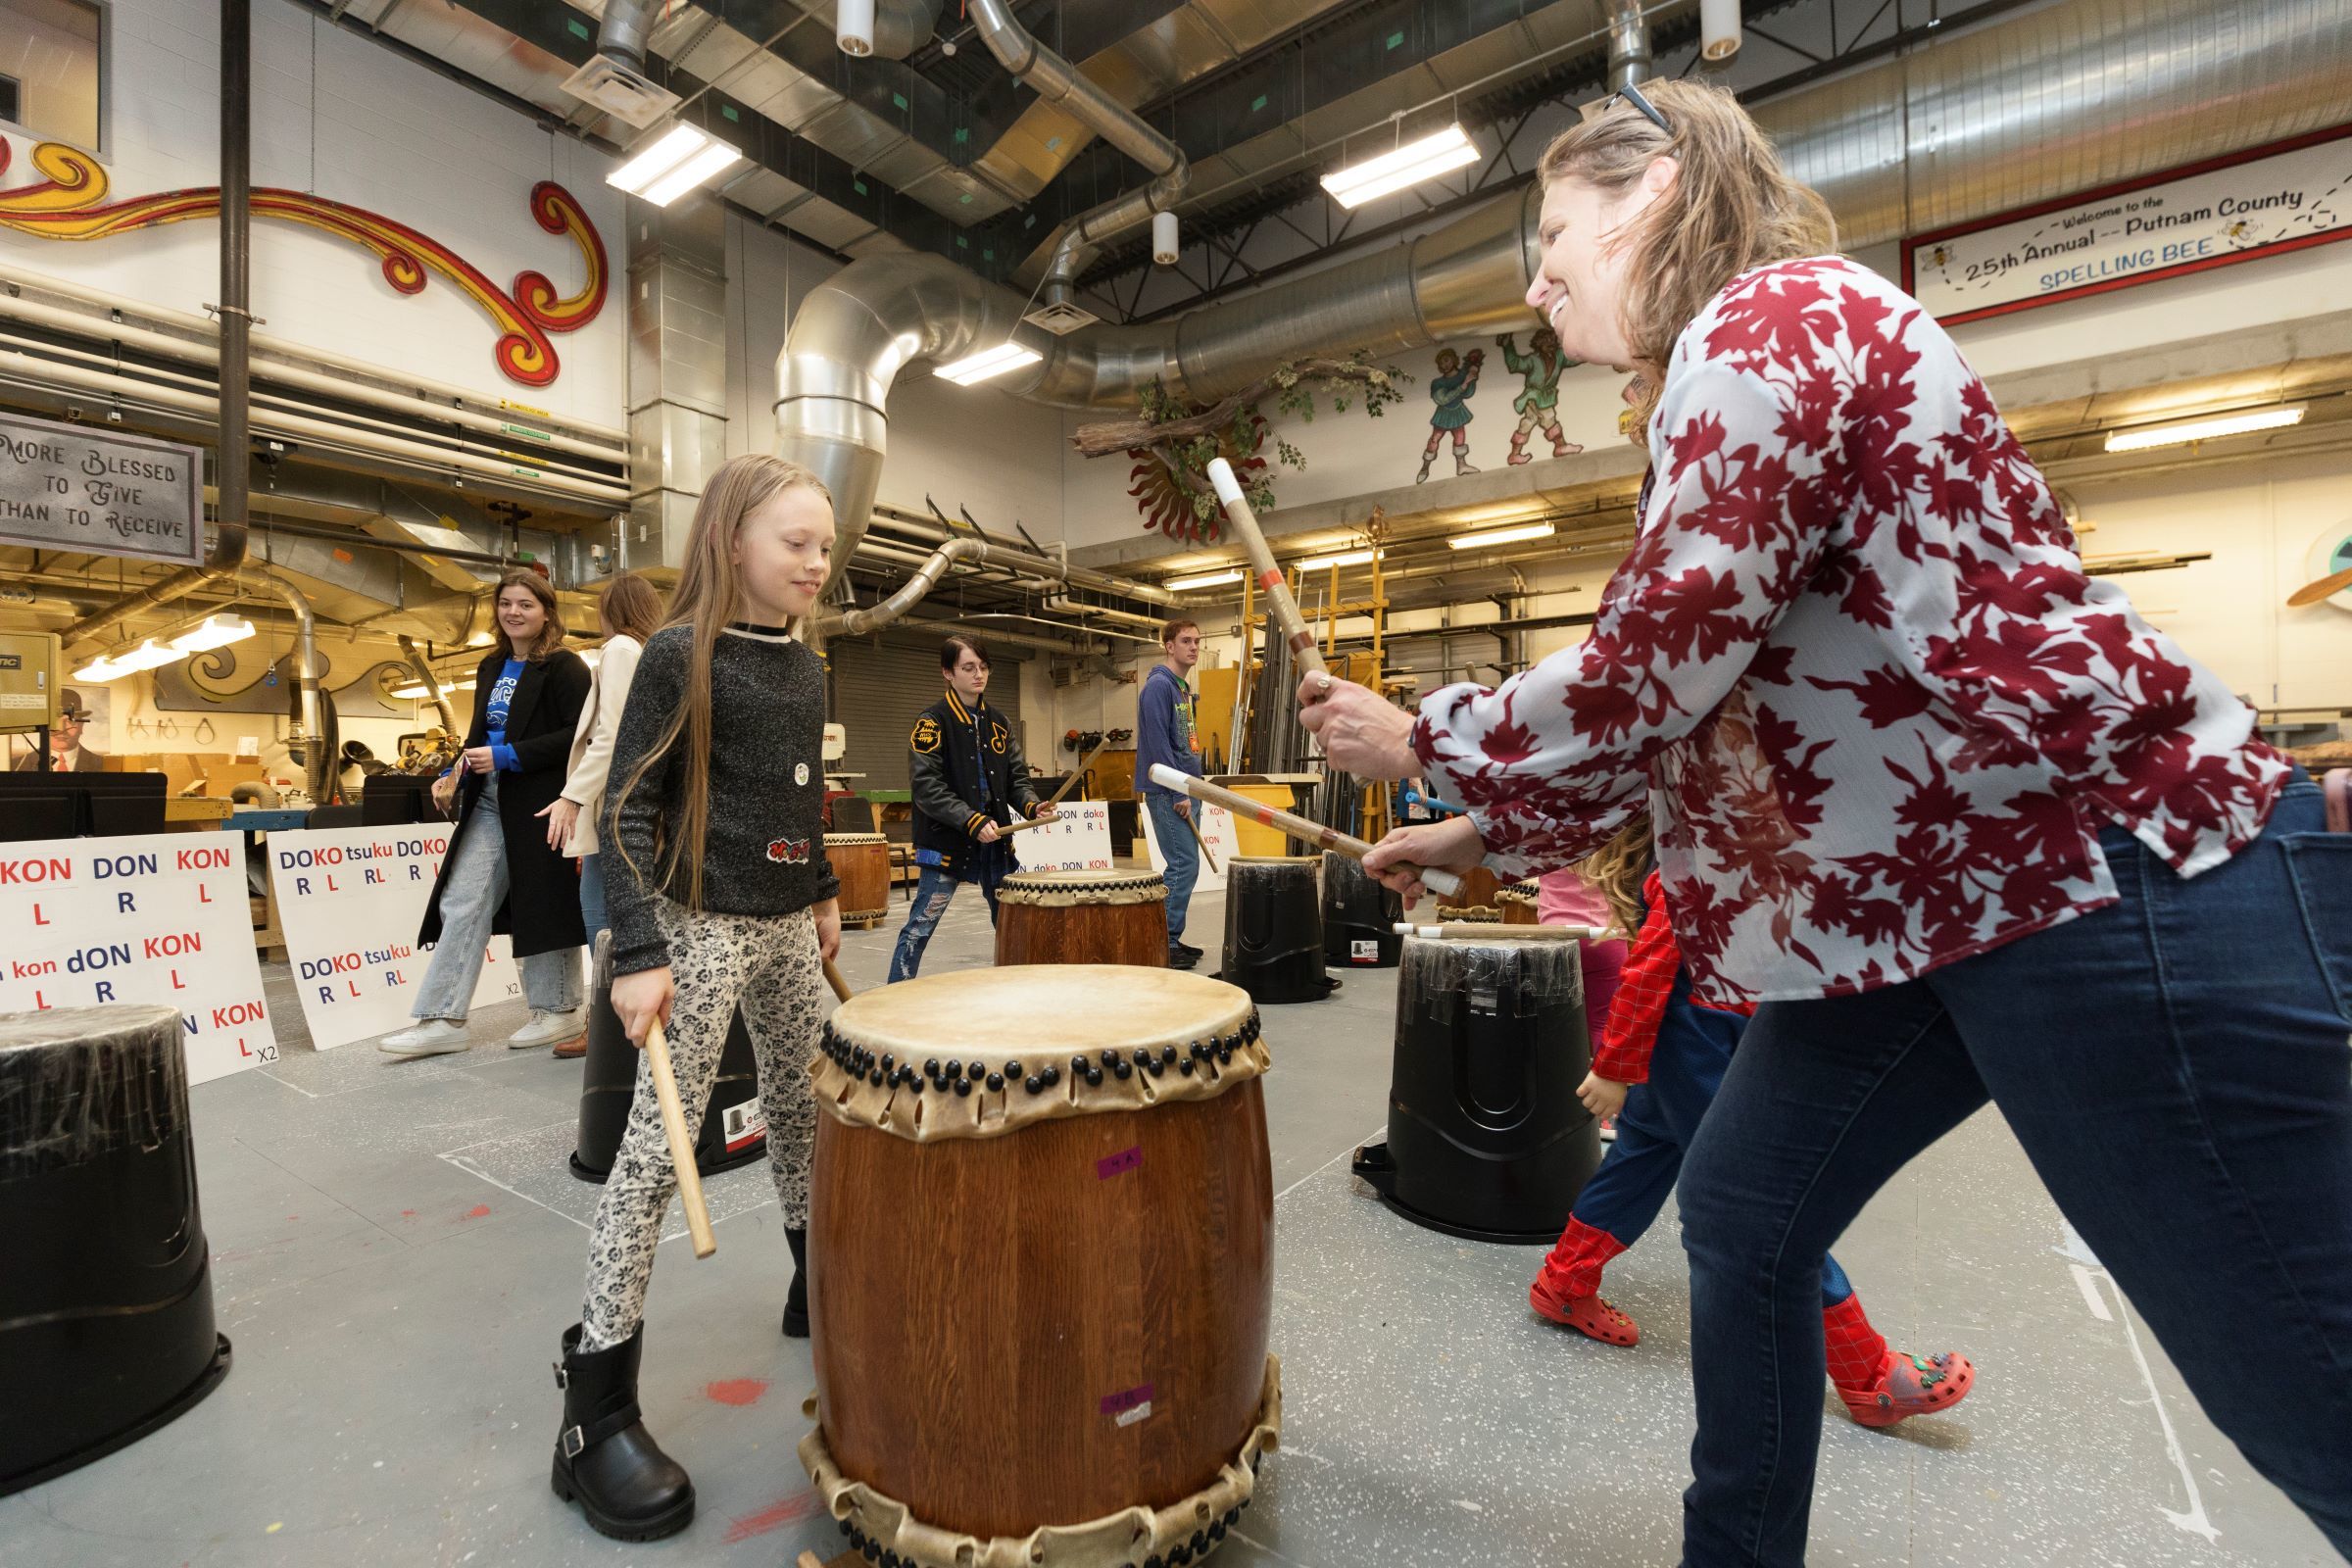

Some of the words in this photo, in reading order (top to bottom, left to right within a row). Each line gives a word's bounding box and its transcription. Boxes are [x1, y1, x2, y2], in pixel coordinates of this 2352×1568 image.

[2062, 207, 2122, 230] Welcome
[2126, 201, 2139, 213] to
[2142, 196, 2164, 210] the
[1965, 251, 2019, 282] 25th
[2024, 229, 2095, 264] Annual
[2126, 207, 2212, 236] Putnam
[2218, 189, 2303, 217] County
[2039, 249, 2155, 292] SPELLING
[2162, 236, 2214, 263] BEE
[0, 433, 65, 465] MORE
[81, 450, 175, 482] BLESSED
[42, 474, 69, 495] TO
[84, 480, 142, 506] GIVE
[65, 508, 90, 526] TO
[106, 511, 183, 538] RECEIVE
[1046, 824, 1052, 834] L
[1066, 824, 1072, 834] R
[1087, 822, 1094, 831] R
[1100, 821, 1104, 831] L
[1083, 808, 1104, 819] doko
[1217, 818, 1222, 827] L
[279, 847, 343, 870] DOKO
[345, 842, 393, 860] tsuku
[397, 838, 447, 858] DOKO
[1203, 836, 1220, 845] KON
[1211, 848, 1216, 857] L
[0, 858, 73, 885] KON
[92, 854, 159, 880] DON
[176, 848, 230, 871] KON
[296, 877, 312, 896] R
[326, 874, 339, 892] L
[409, 863, 421, 881] R
[1061, 861, 1083, 871] DON
[1089, 859, 1108, 869] KON
[33, 903, 51, 926] L
[117, 891, 137, 913] R
[198, 883, 213, 904] L
[12, 958, 58, 979] kon
[67, 943, 132, 974] dON
[143, 932, 202, 959] KON
[300, 952, 362, 981] DOKO
[364, 944, 412, 965] tsuku
[35, 990, 52, 1011] L
[95, 980, 116, 1004] R
[171, 969, 186, 990] L
[318, 985, 335, 1004] R
[348, 980, 362, 998] L
[485, 948, 496, 963] L
[506, 982, 520, 996] X2
[212, 1000, 265, 1029] KON
[238, 1037, 253, 1057] L
[256, 1045, 278, 1063] X2
